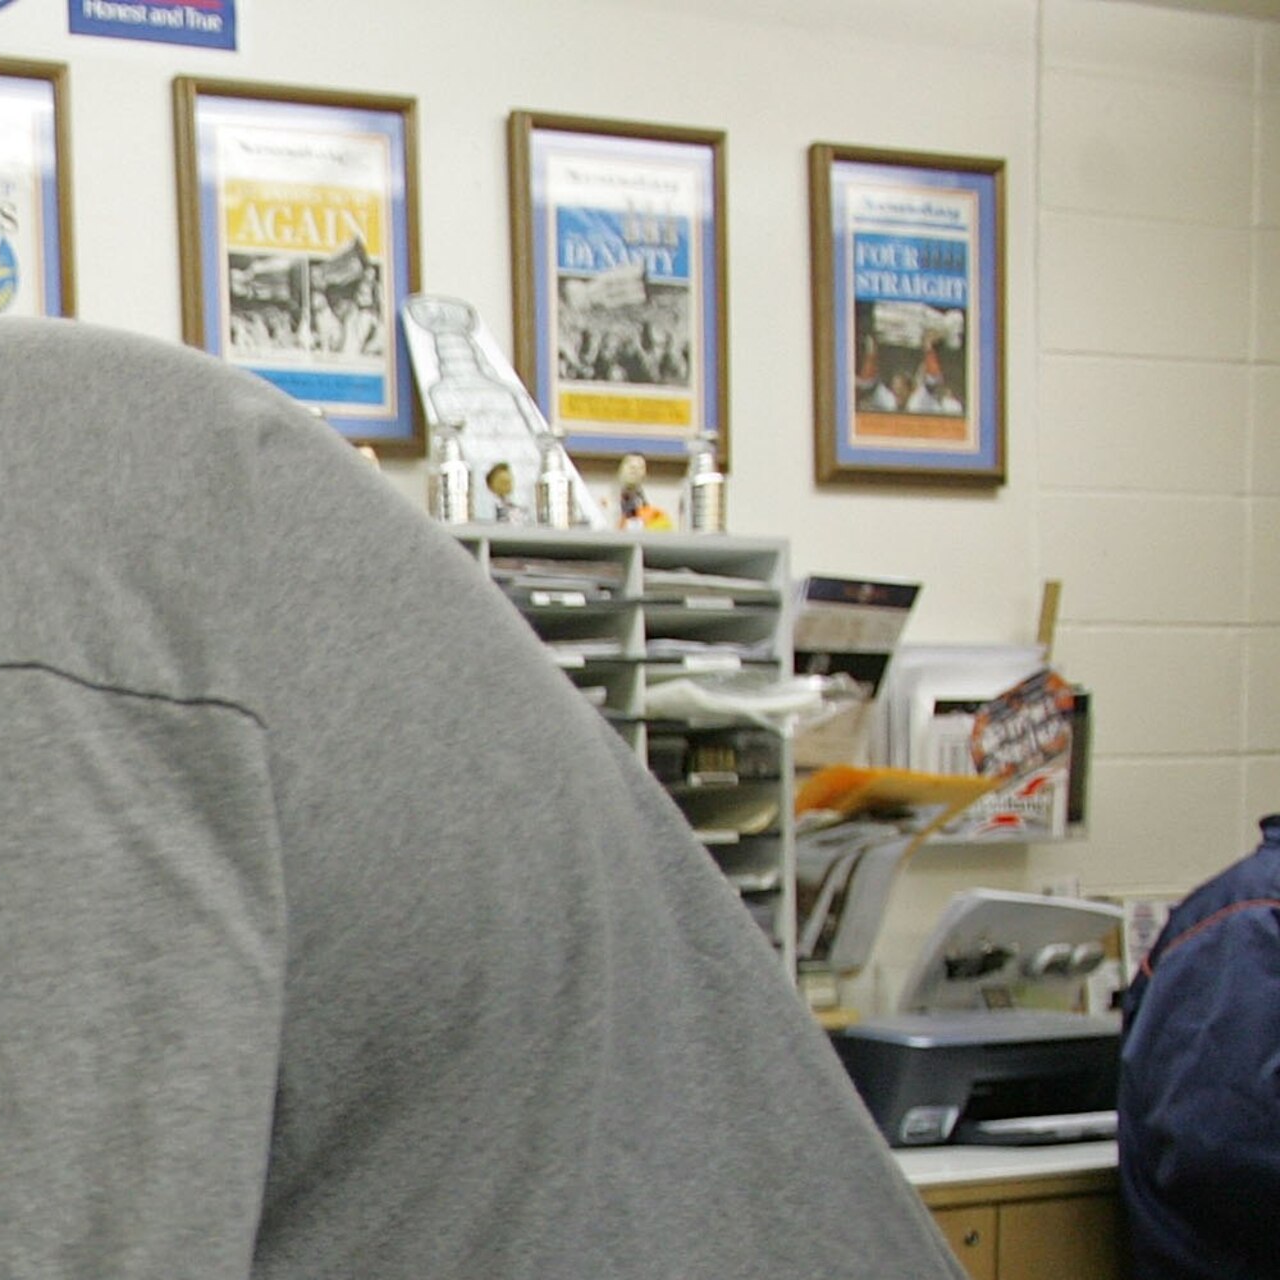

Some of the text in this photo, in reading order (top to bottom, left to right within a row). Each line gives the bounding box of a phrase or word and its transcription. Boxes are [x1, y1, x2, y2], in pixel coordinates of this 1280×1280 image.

[82, 1, 224, 33] Honest and True
[237, 200, 369, 248] AGAIN
[564, 231, 677, 275] DYNASTY
[855, 240, 920, 269] FOUR
[855, 270, 967, 300] STRAIGHT
